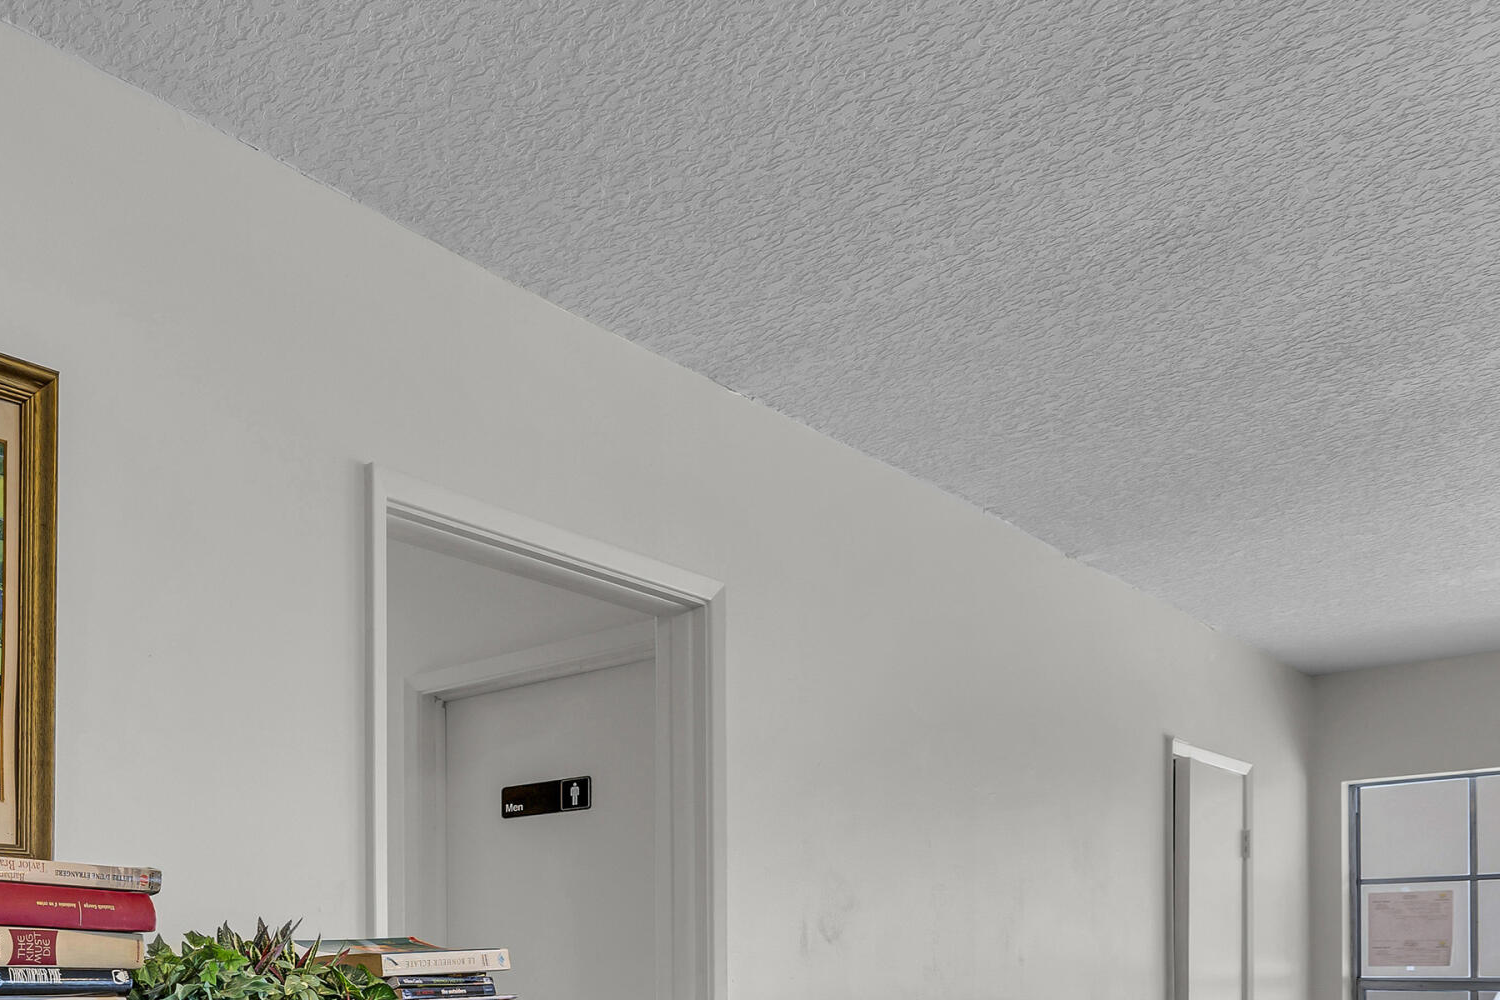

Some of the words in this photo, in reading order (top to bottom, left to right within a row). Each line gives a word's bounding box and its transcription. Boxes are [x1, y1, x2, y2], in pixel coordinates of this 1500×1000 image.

[505, 803, 524, 813] Men
[17, 935, 26, 959] THE
[26, 933, 34, 961] KING
[34, 931, 43, 963] MUST
[43, 939, 51, 957] DIE
[9, 968, 49, 984] CHRISTOPHER
